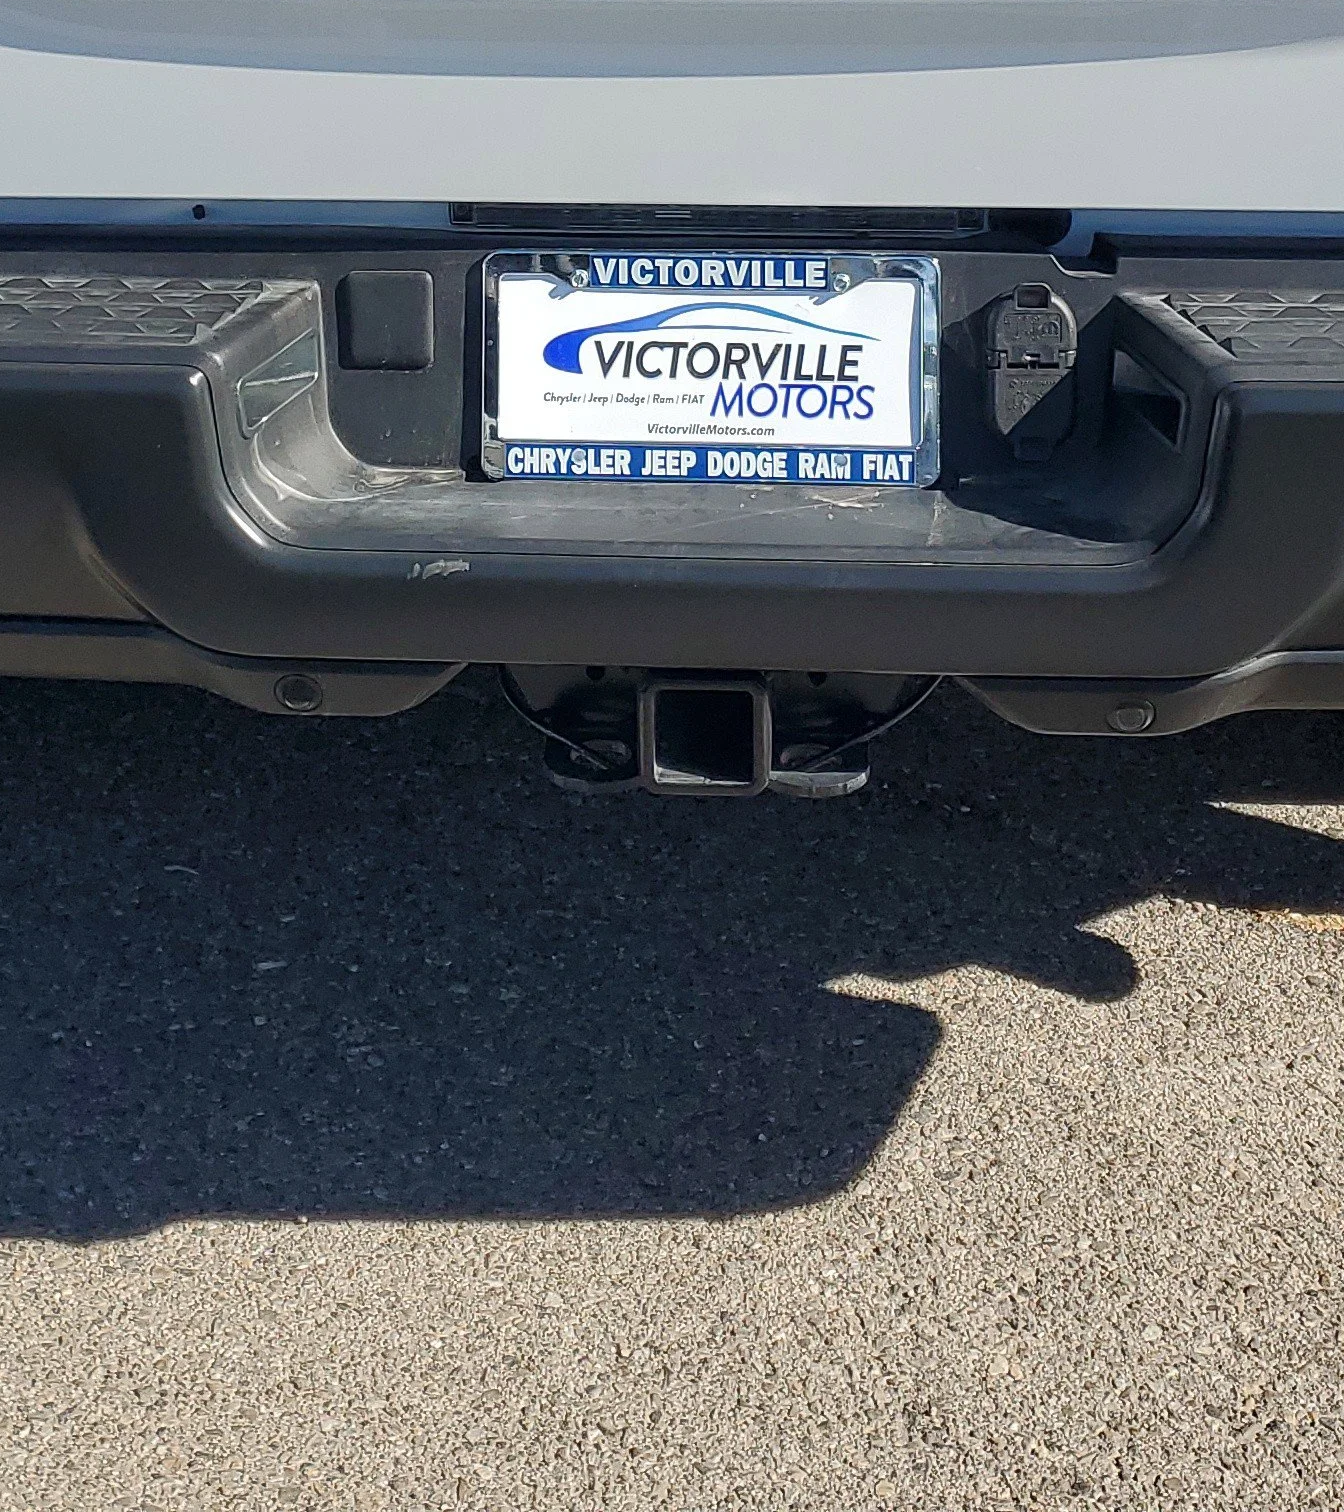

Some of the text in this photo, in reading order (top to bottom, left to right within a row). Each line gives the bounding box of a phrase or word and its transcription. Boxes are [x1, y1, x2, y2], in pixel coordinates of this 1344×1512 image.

[593, 258, 827, 288] VICTORVILLE
[594, 340, 863, 382] VICTORVILLE
[543, 392, 705, 406] Chrysler Jeep Dodge Ram FIAT
[709, 382, 875, 420] MOTORS
[647, 423, 775, 437] VictorvilleMotors.com
[507, 446, 914, 481] CHRYSLER JEEP DODGE RAM FIAT
